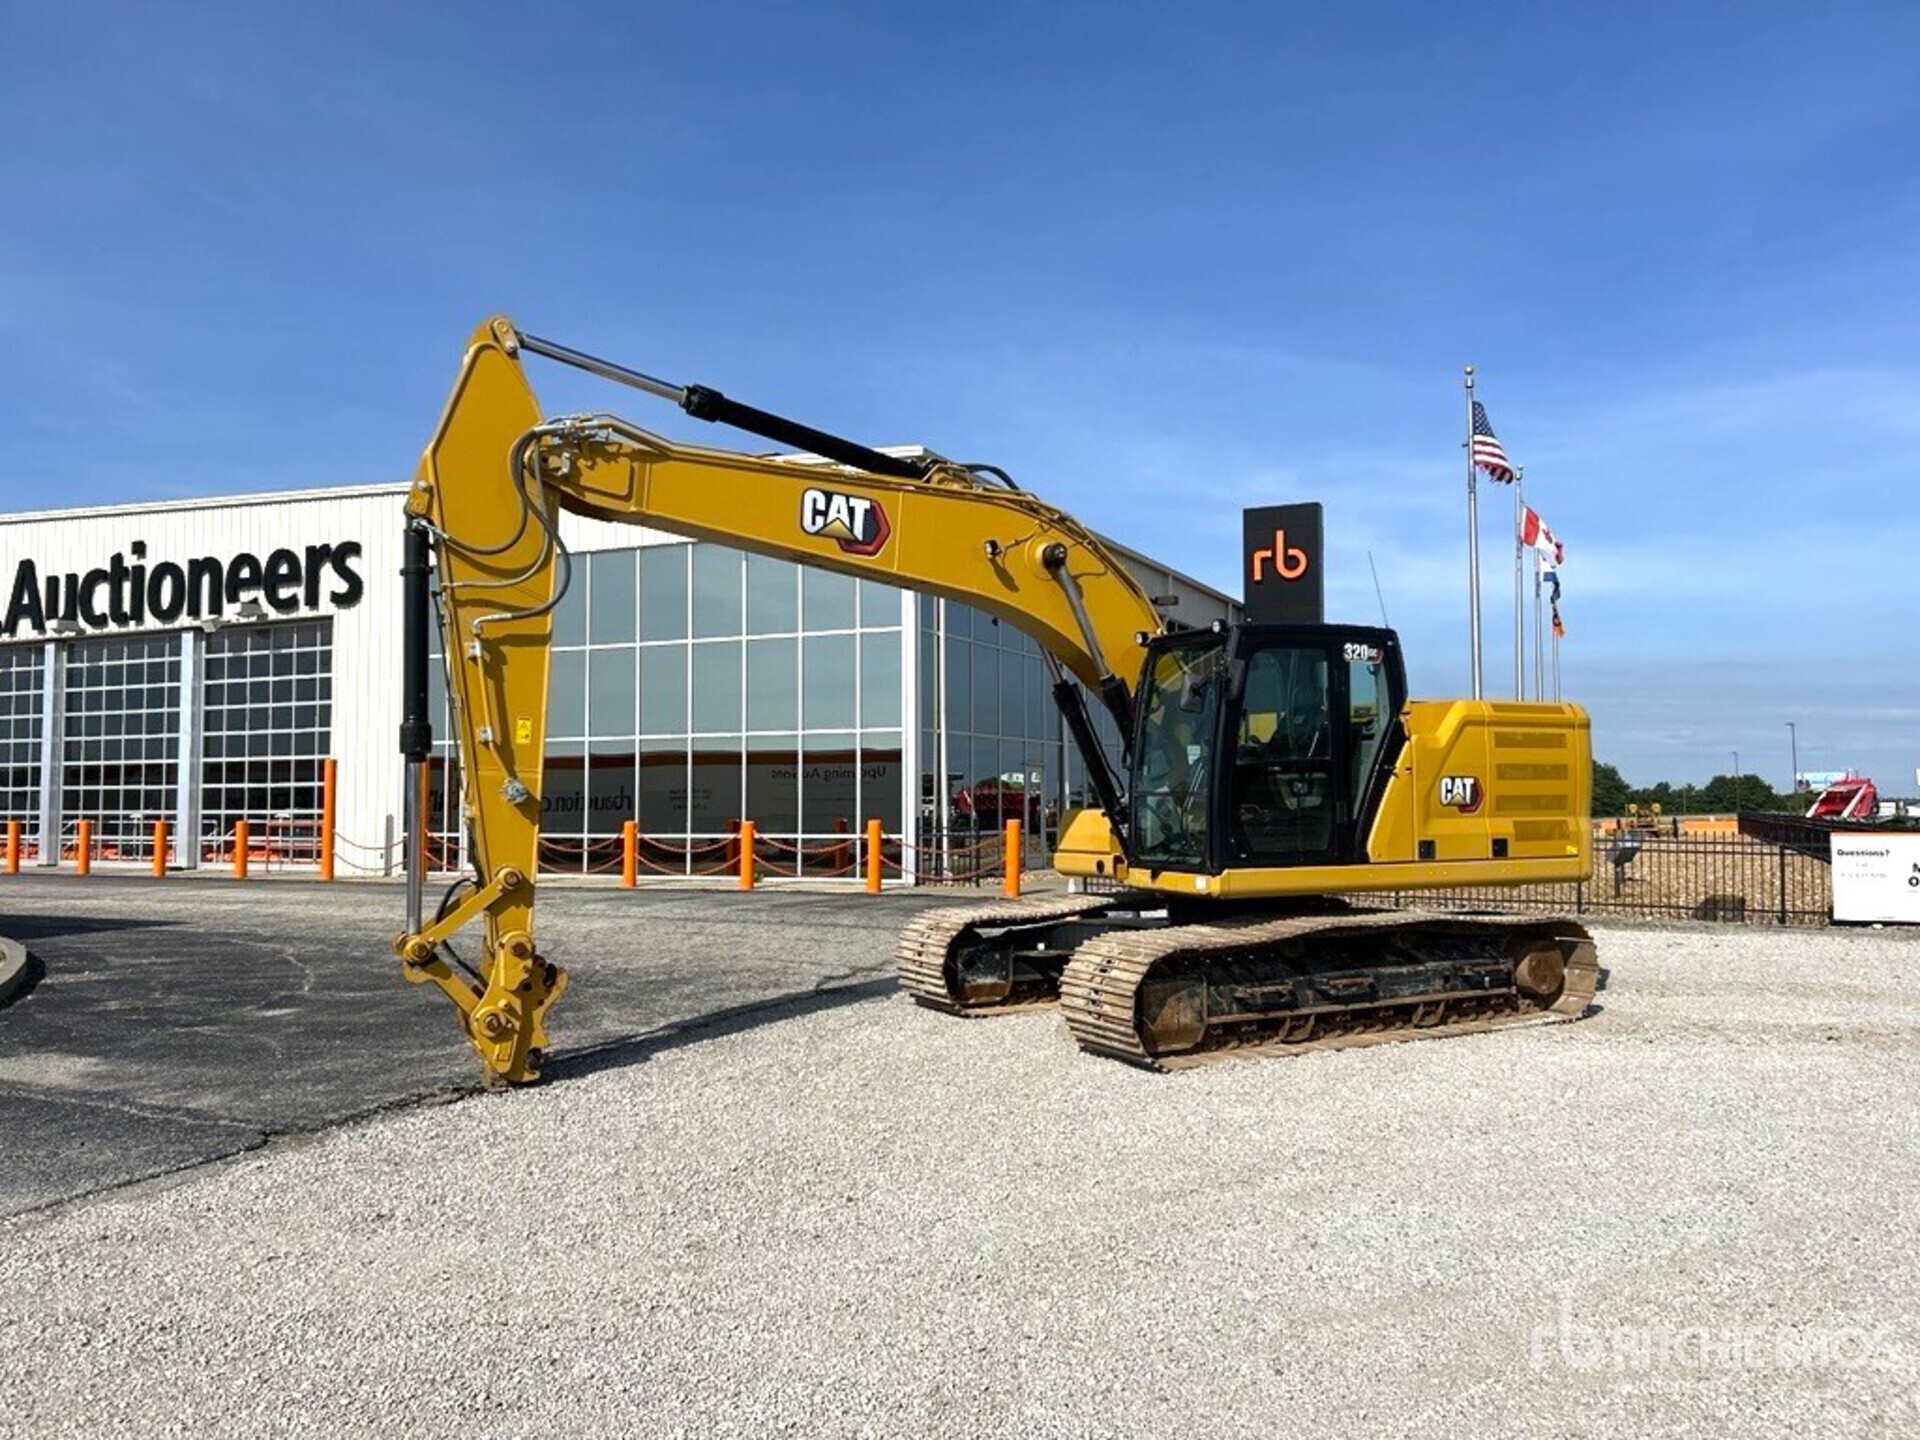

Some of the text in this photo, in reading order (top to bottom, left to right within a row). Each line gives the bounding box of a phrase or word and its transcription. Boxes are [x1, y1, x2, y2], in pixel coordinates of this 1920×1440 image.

[803, 489, 871, 541] CAT
[1253, 529, 1308, 581] rb
[1, 540, 363, 636] Auctioneers
[1342, 642, 1368, 661] 320
[1441, 777, 1474, 805] CAT
[1837, 848, 1890, 857] Questions?
